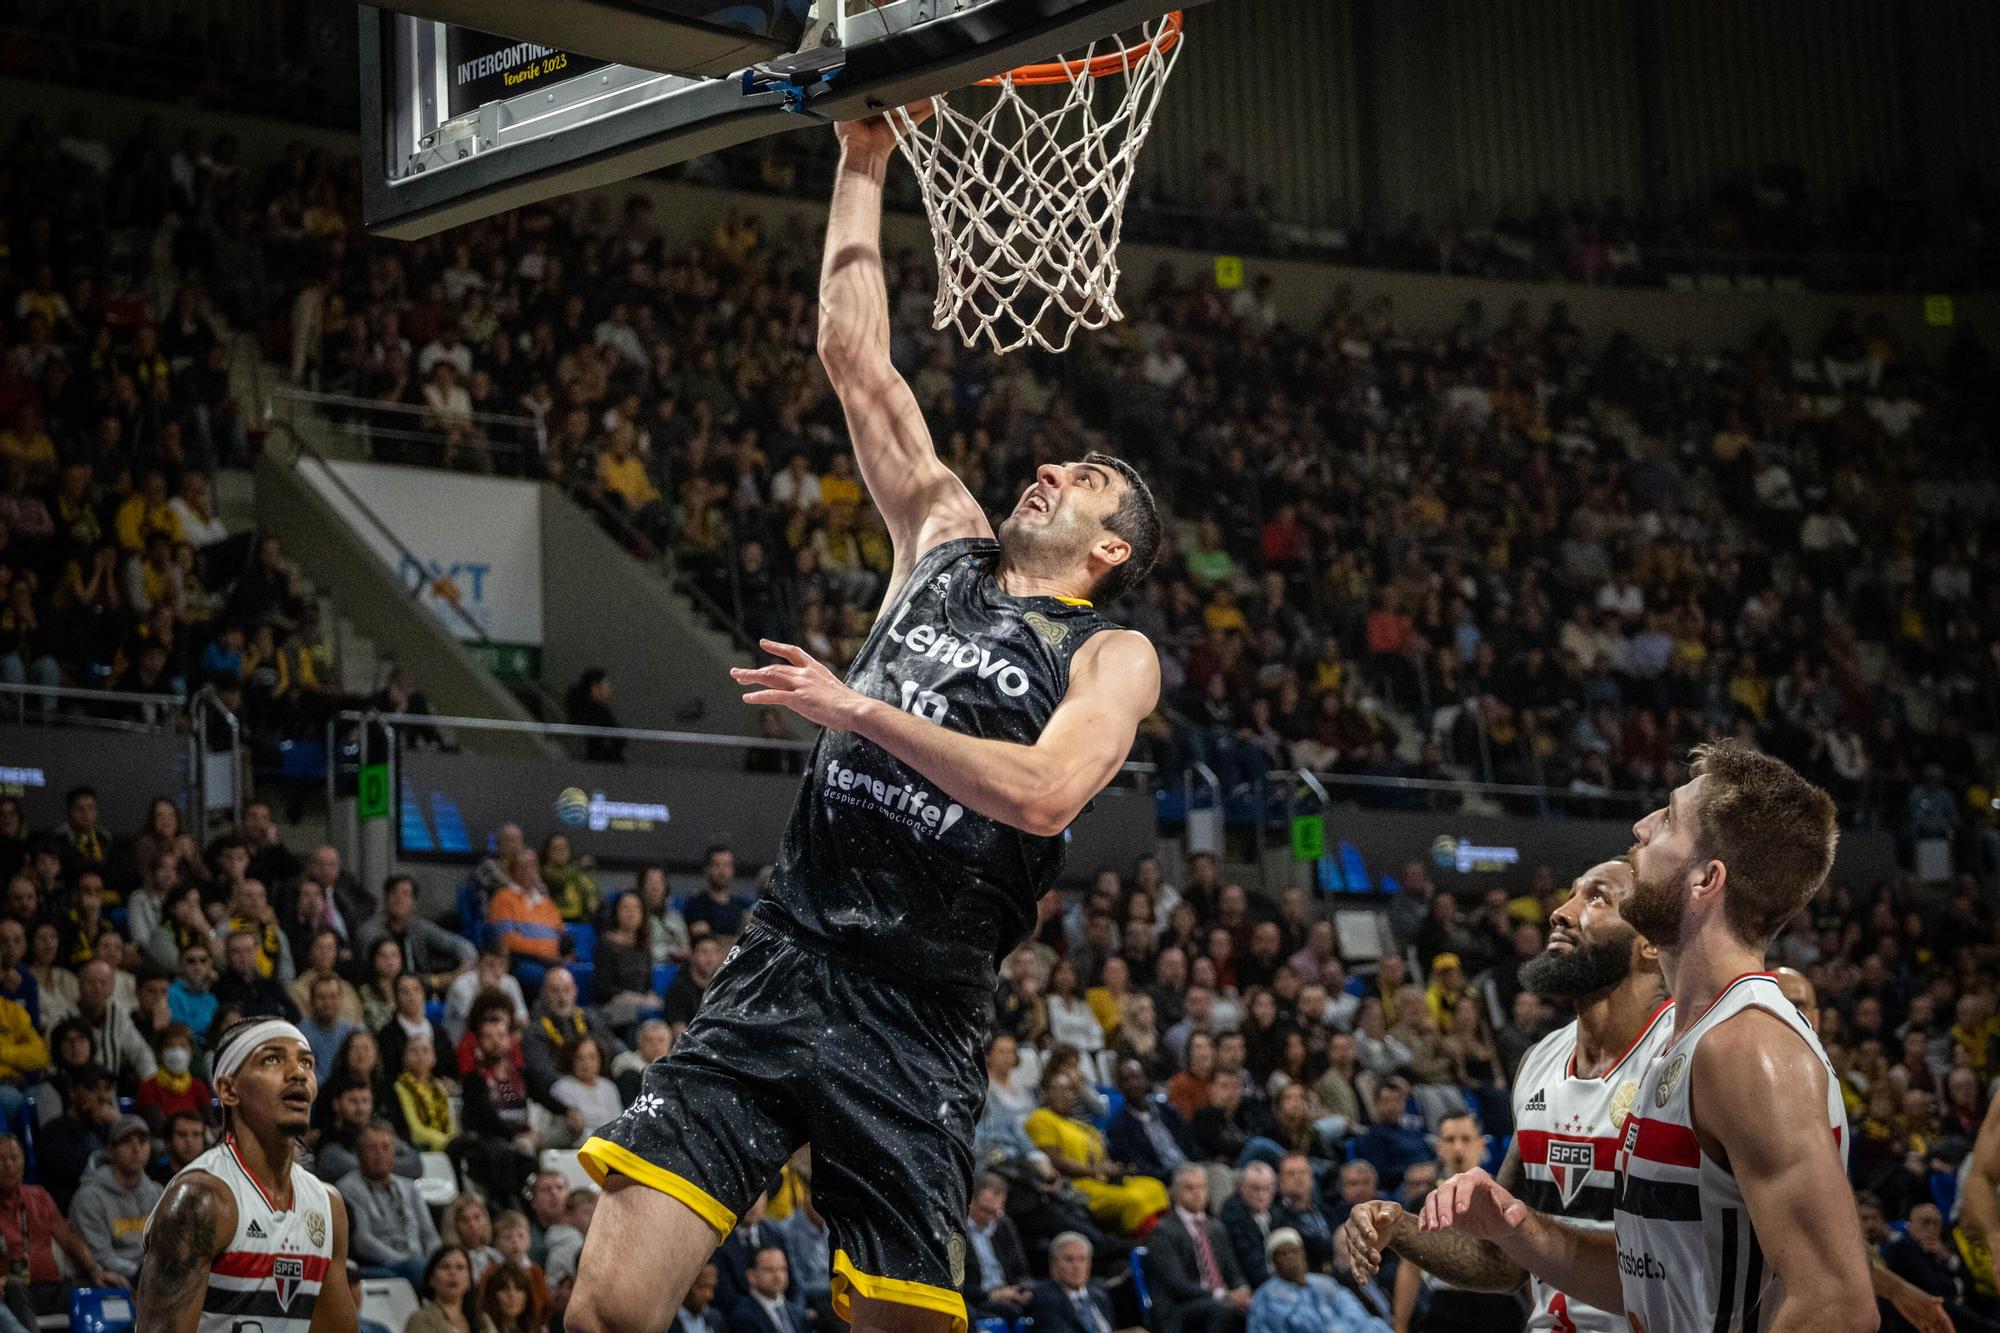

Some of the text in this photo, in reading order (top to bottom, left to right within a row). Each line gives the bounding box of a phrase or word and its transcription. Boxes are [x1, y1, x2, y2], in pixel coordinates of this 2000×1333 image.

[503, 53, 567, 86] Tenerife 2023
[887, 600, 1030, 697] Lenovo
[823, 788, 875, 811] despierta
[1524, 1103, 1547, 1112] adidas
[1551, 1146, 1590, 1163] SPFC
[275, 1261, 301, 1276] SPFC
